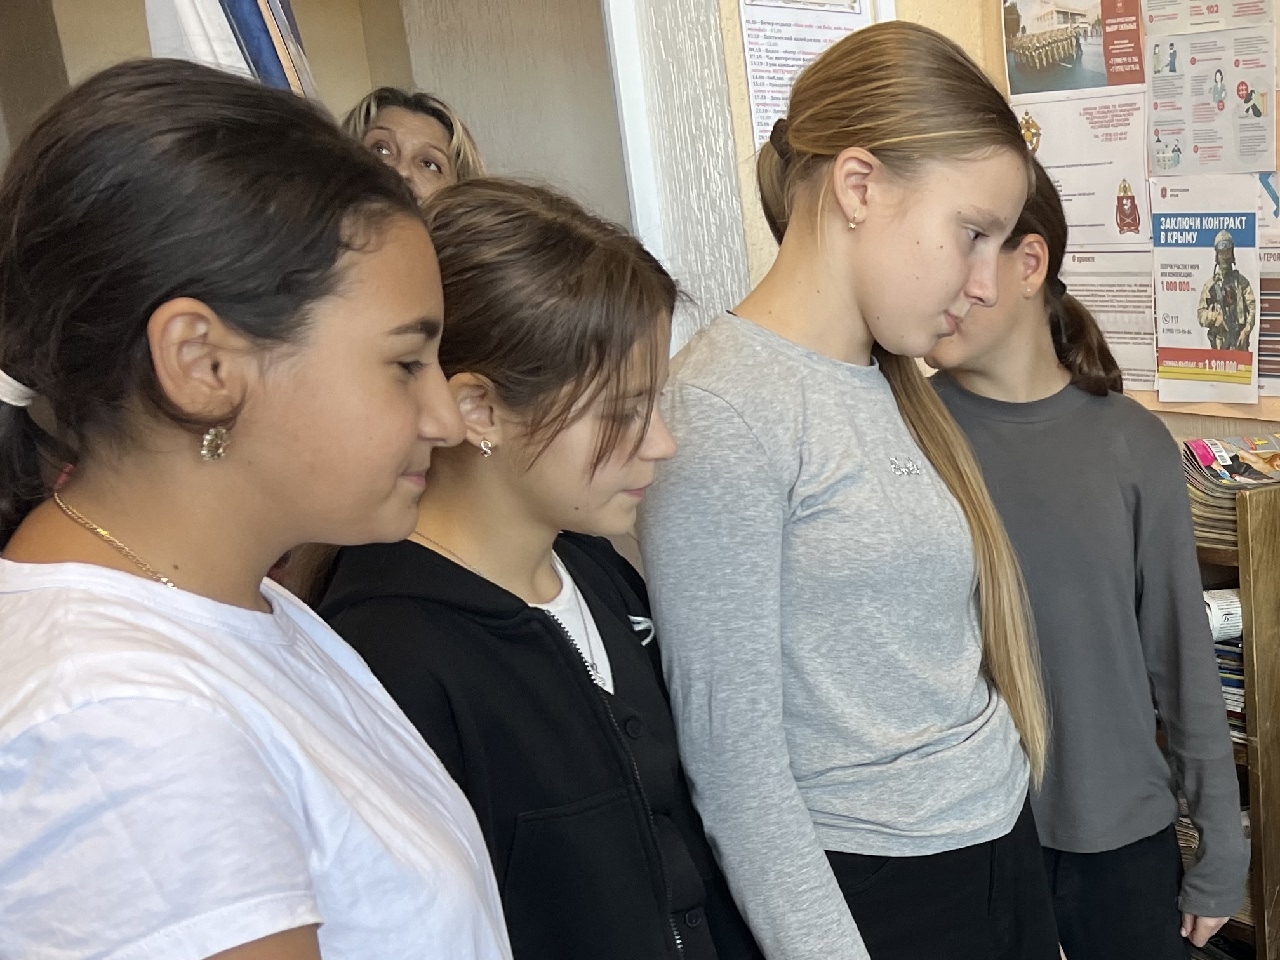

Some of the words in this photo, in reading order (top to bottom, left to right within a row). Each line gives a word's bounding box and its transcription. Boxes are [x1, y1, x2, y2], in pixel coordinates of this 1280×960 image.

[1160, 217, 1200, 230] ЗАКЛЮЧИ
[1202, 216, 1247, 230] КОНТРАКТ
[1161, 232, 1166, 243] В
[1168, 231, 1198, 244] КРЫМУ
